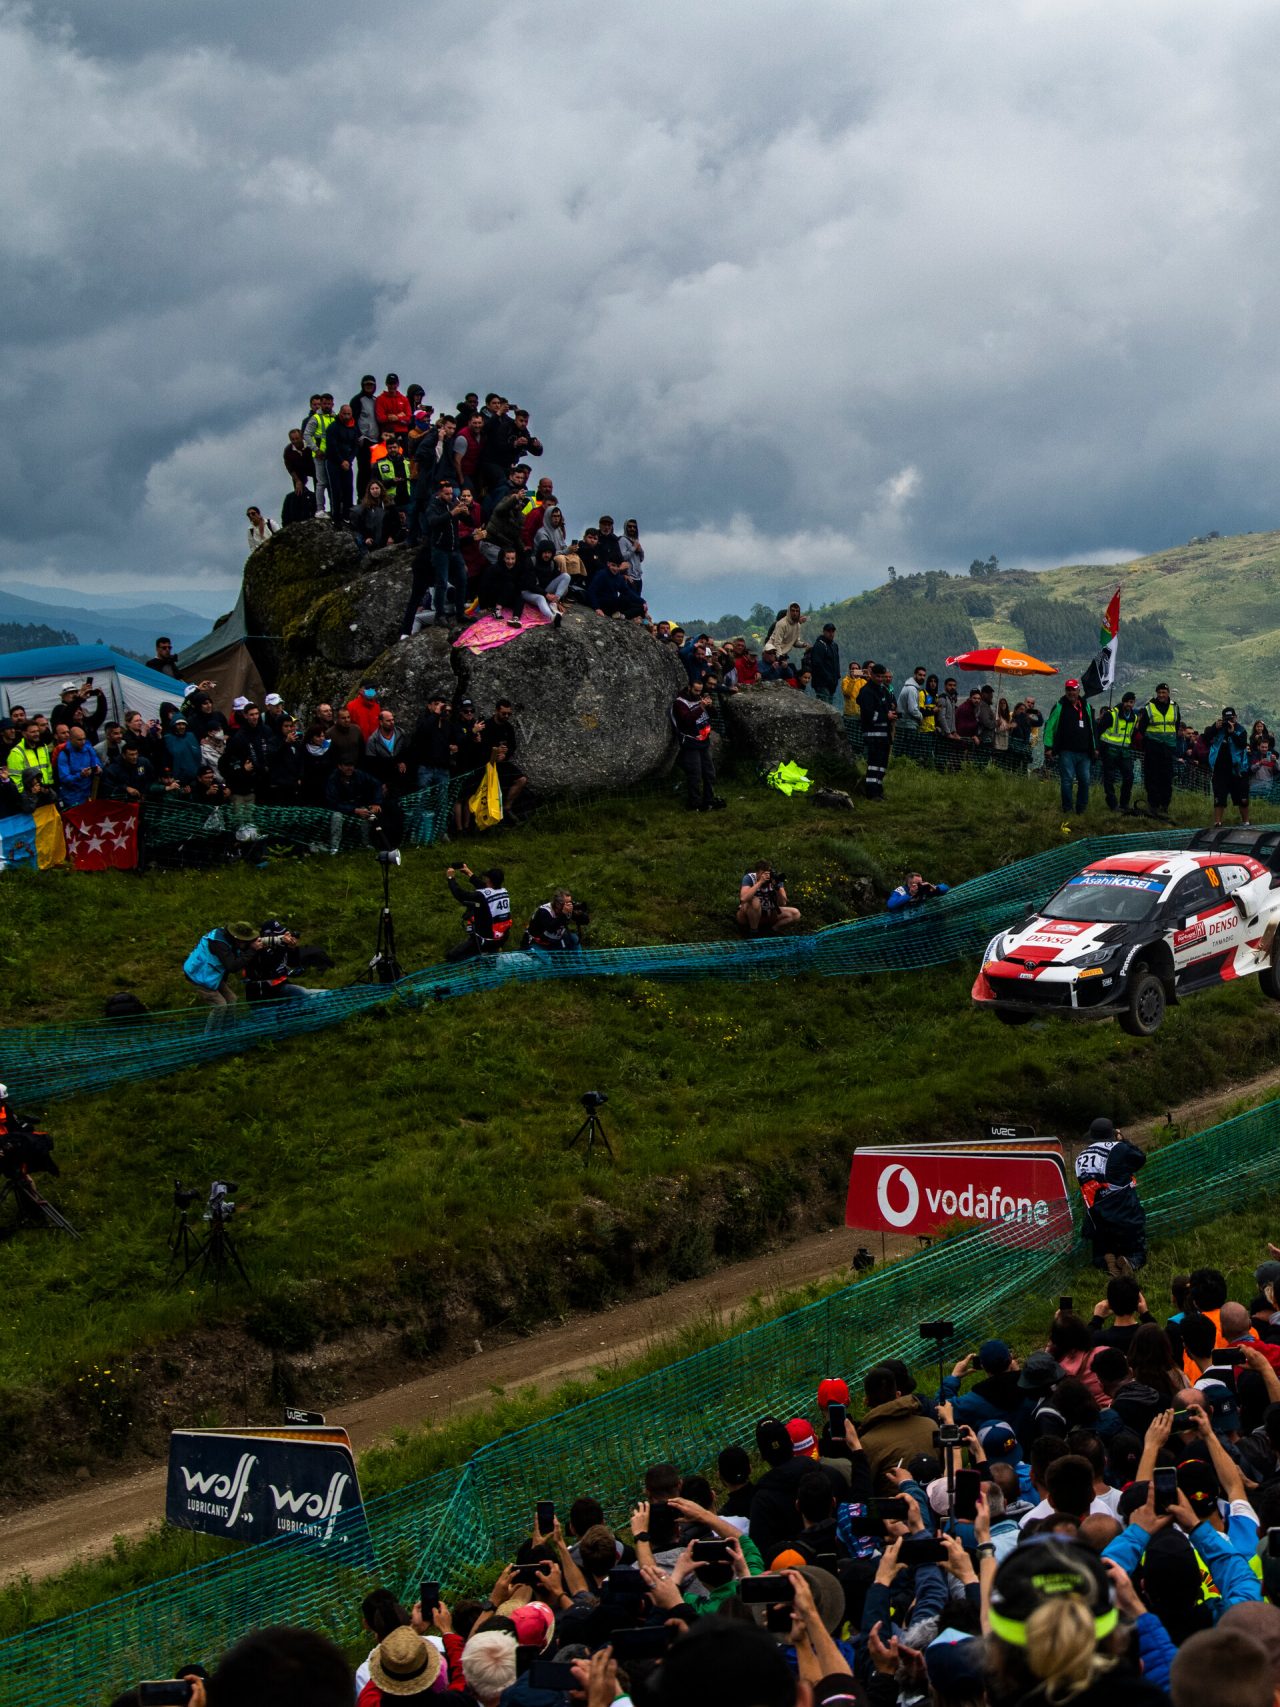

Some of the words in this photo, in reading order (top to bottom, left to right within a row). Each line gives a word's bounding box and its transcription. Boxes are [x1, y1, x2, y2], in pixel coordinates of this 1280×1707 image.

[1080, 877, 1152, 889] AsahiKASEI
[1205, 867, 1220, 888] 18
[1209, 916, 1239, 936] DENSO
[1025, 934, 1073, 945] DENSO
[991, 1126, 1016, 1136] WRC
[925, 1184, 1049, 1226] vodafone
[286, 1410, 309, 1422] WRC
[187, 1498, 229, 1518] LUBRICANTS
[277, 1518, 322, 1538] LUBRICANTS
